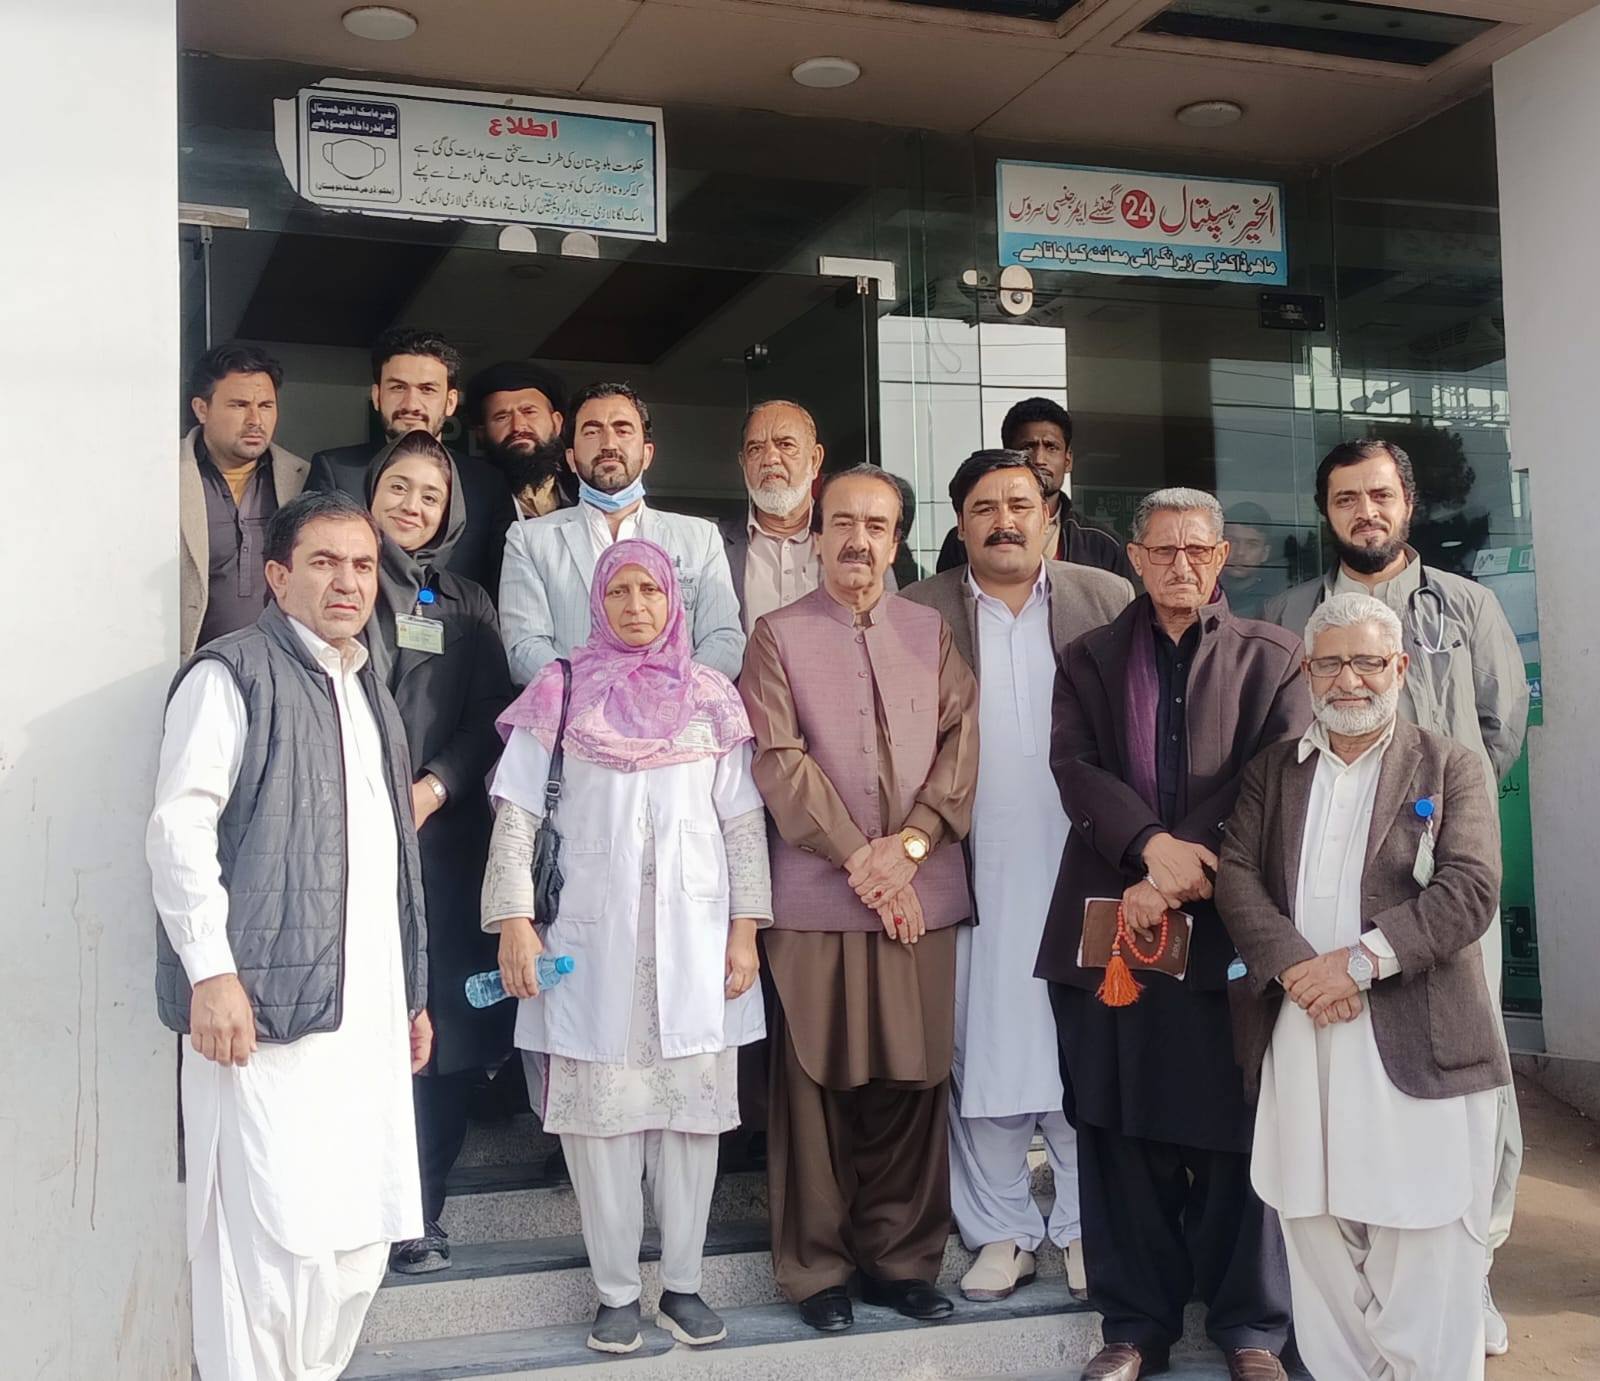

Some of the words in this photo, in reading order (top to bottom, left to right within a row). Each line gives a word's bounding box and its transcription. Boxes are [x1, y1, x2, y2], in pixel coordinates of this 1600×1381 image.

[488, 116, 558, 139] اطلاع
[536, 152, 563, 168] طرف
[562, 151, 576, 169] کی
[573, 155, 612, 172] بلوچستان
[611, 158, 645, 173] حکومت
[1008, 195, 1046, 224] سروس
[1045, 185, 1087, 227] ایمرجنسی
[1088, 182, 1122, 225] گھنٹے
[1125, 195, 1154, 222] 24
[1158, 183, 1240, 241] ہسپتال
[1230, 191, 1276, 243] الخیر
[1129, 246, 1174, 271] نگرانی
[1174, 252, 1193, 272] زیر
[1193, 253, 1214, 275] کے
[1213, 250, 1248, 275] ڈاکٹر
